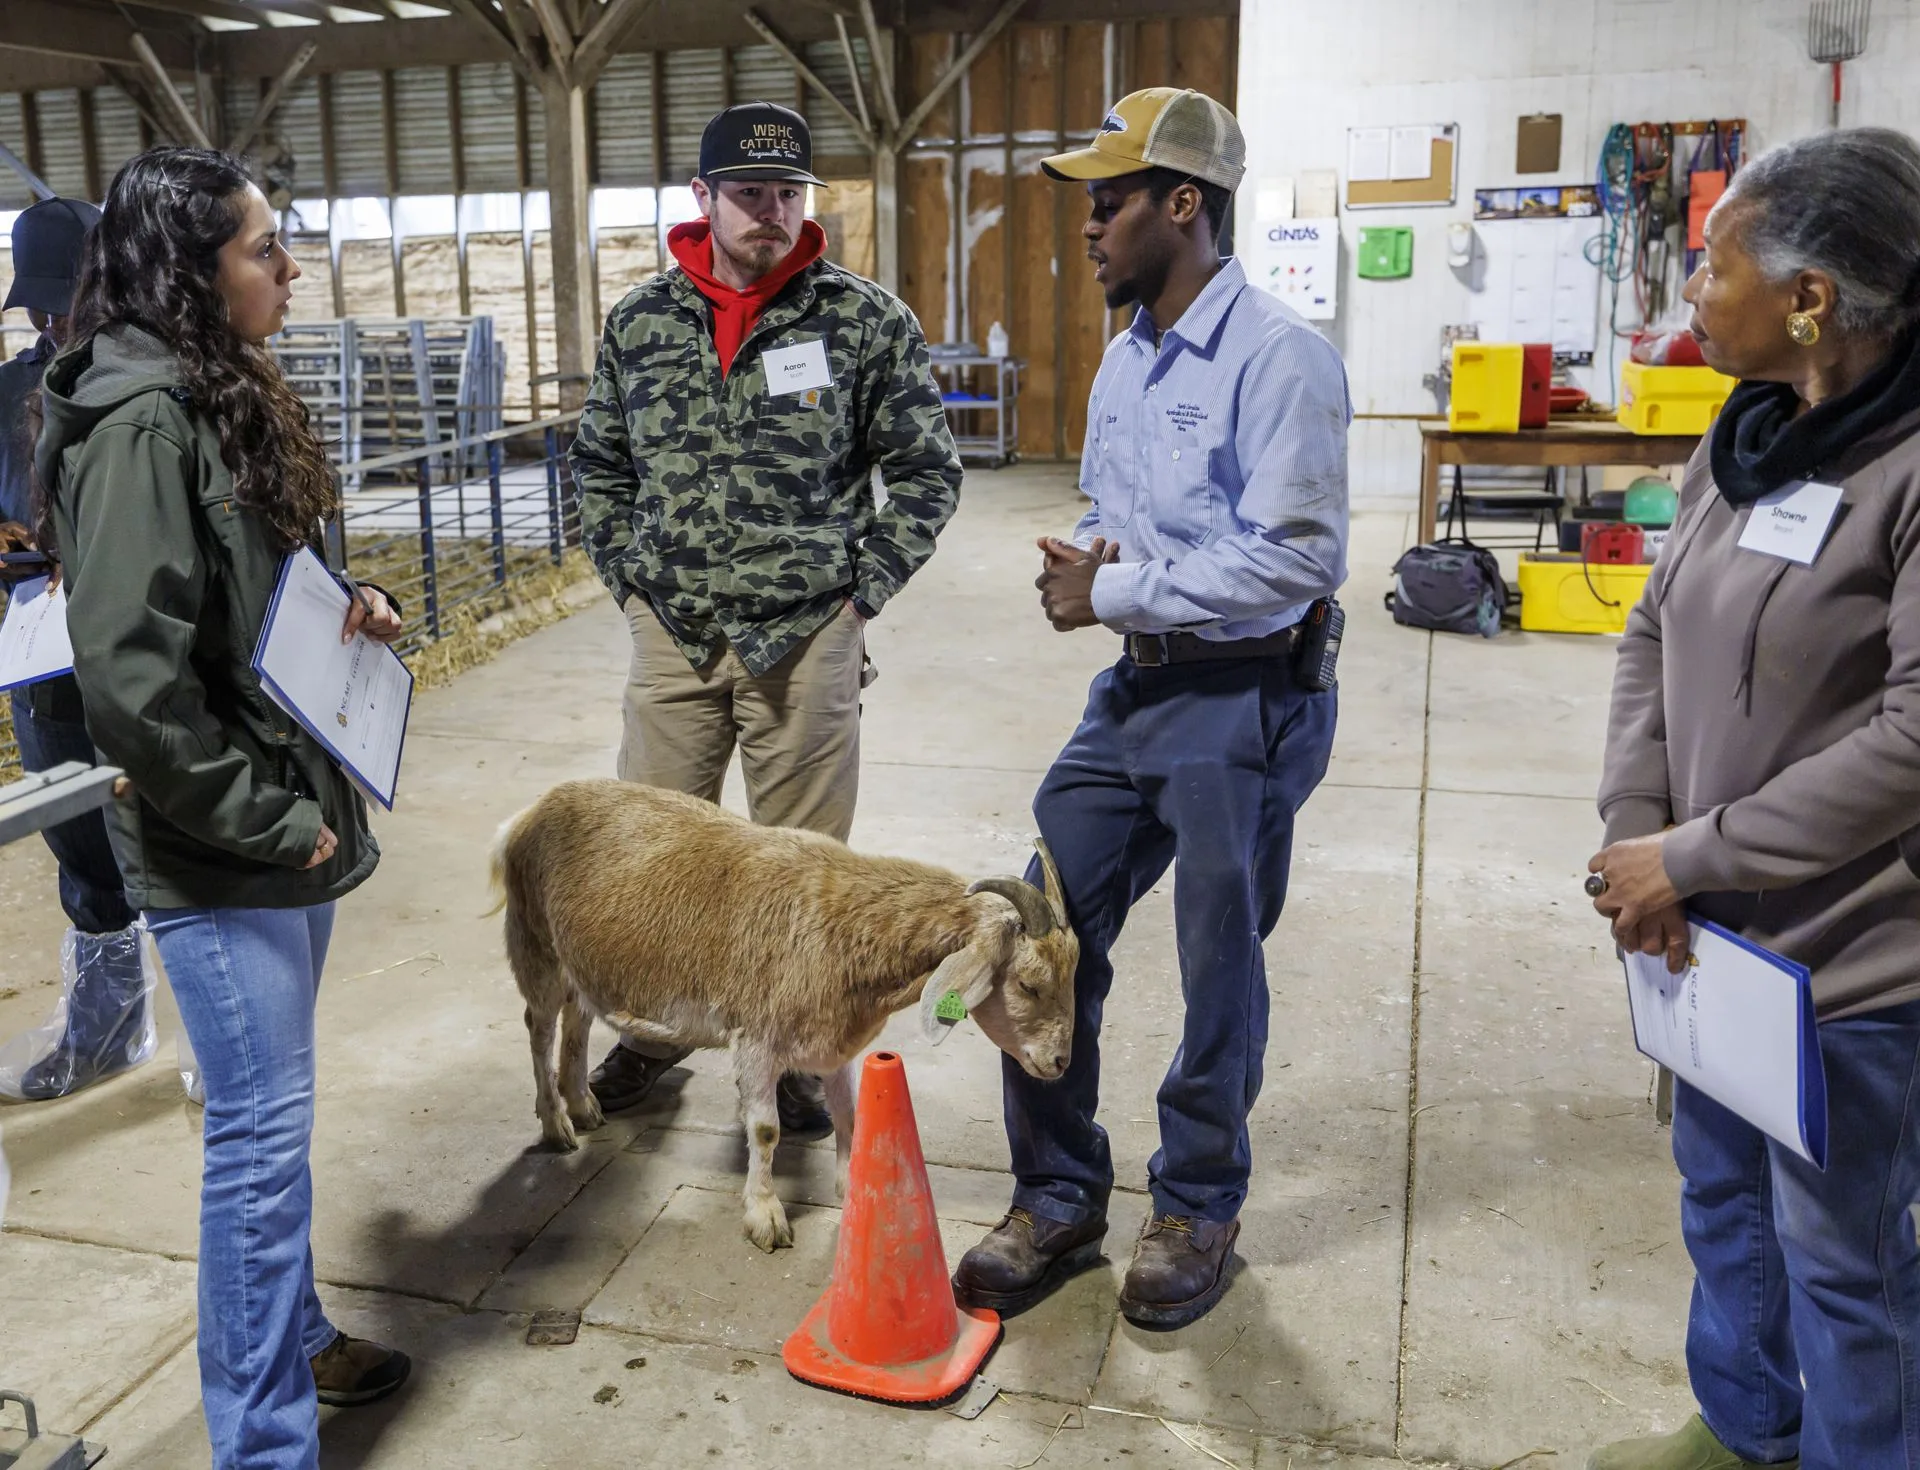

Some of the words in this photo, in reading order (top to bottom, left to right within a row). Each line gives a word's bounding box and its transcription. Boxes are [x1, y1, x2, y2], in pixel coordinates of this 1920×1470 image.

[753, 124, 793, 139] WBHC
[740, 138, 788, 150] CATTLE
[784, 362, 806, 372] Aaron
[1771, 506, 1807, 523] Shawne
